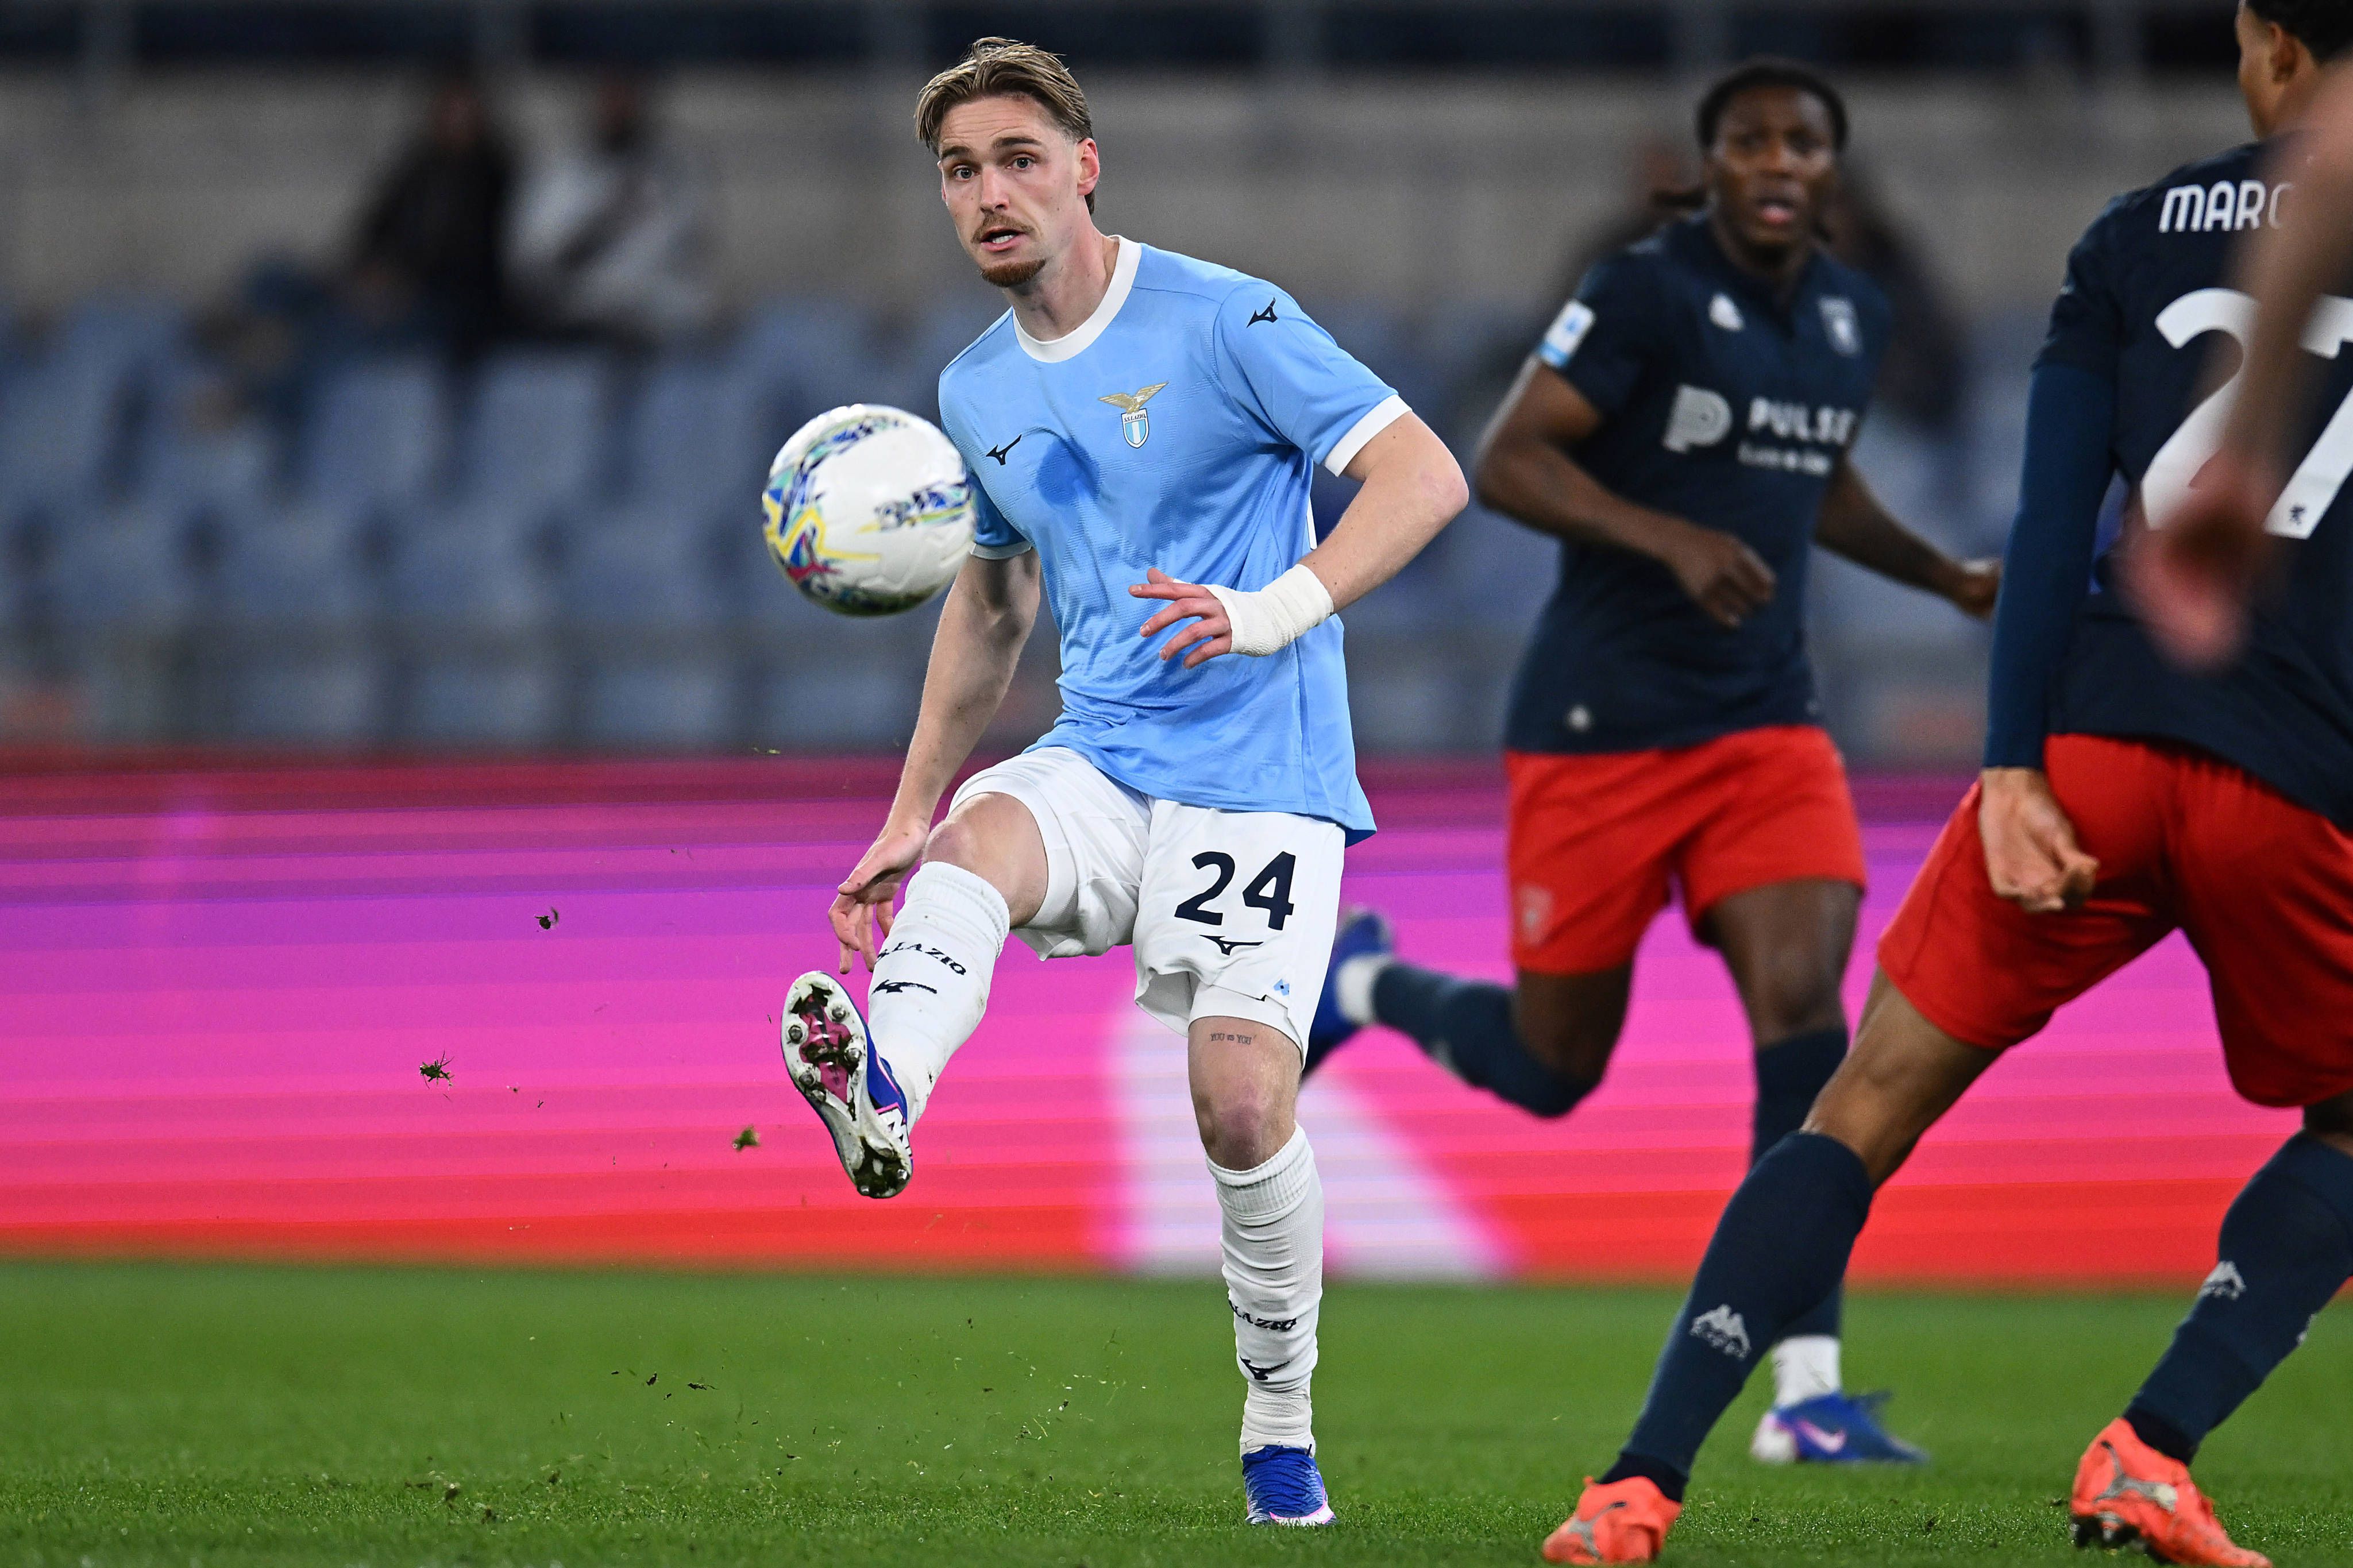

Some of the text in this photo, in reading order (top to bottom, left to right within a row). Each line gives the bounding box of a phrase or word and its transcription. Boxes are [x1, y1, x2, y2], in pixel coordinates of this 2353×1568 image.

[2140, 288, 2353, 539] 27
[1174, 851, 1296, 931] 24
[1210, 1033, 1225, 1041] YOU
[1237, 1034, 1252, 1045] YOU
